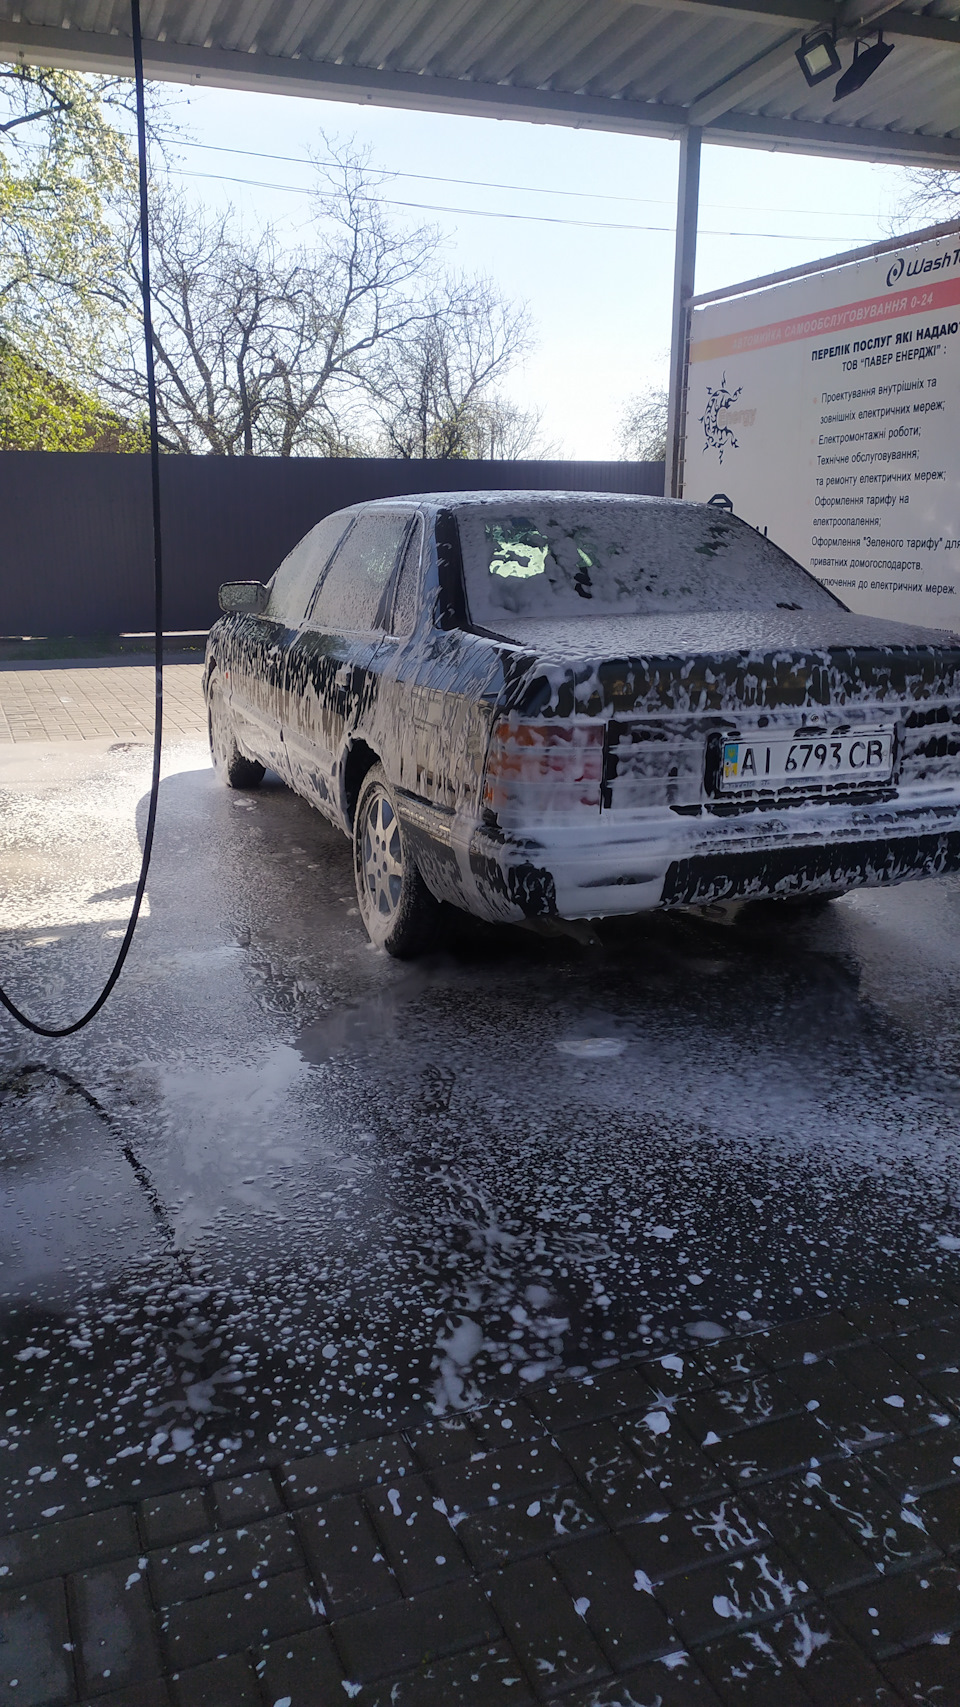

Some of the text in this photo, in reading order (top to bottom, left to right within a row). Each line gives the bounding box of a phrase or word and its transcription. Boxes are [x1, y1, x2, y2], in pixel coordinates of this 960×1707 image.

[785, 297, 908, 337] САМООБСЛУГОВУВАННЯ
[911, 292, 934, 308] 0-24
[811, 321, 960, 361] ПЕРЕЛІК ПОСЛУГ ЯКІ НАДАЮ
[842, 359, 858, 371] ТОВ
[821, 378, 937, 404] Проектування внутрішніх та
[820, 400, 946, 425] зовнішніх електричних мереж;
[818, 425, 922, 445] Електромонтажні роботи;
[817, 449, 920, 466] Технічне обслуговування;
[815, 470, 947, 488] та ремонту електричних мереж;
[814, 493, 910, 508] Оформлення тарифу на
[812, 517, 882, 528] електроопалення;
[811, 536, 861, 548] Оформлення
[809, 557, 923, 571] приватних домогосподарств.
[857, 580, 868, 590] до
[870, 580, 921, 593] електричних
[925, 584, 957, 596] мереж.
[740, 740, 883, 777] AI 6793 CB
